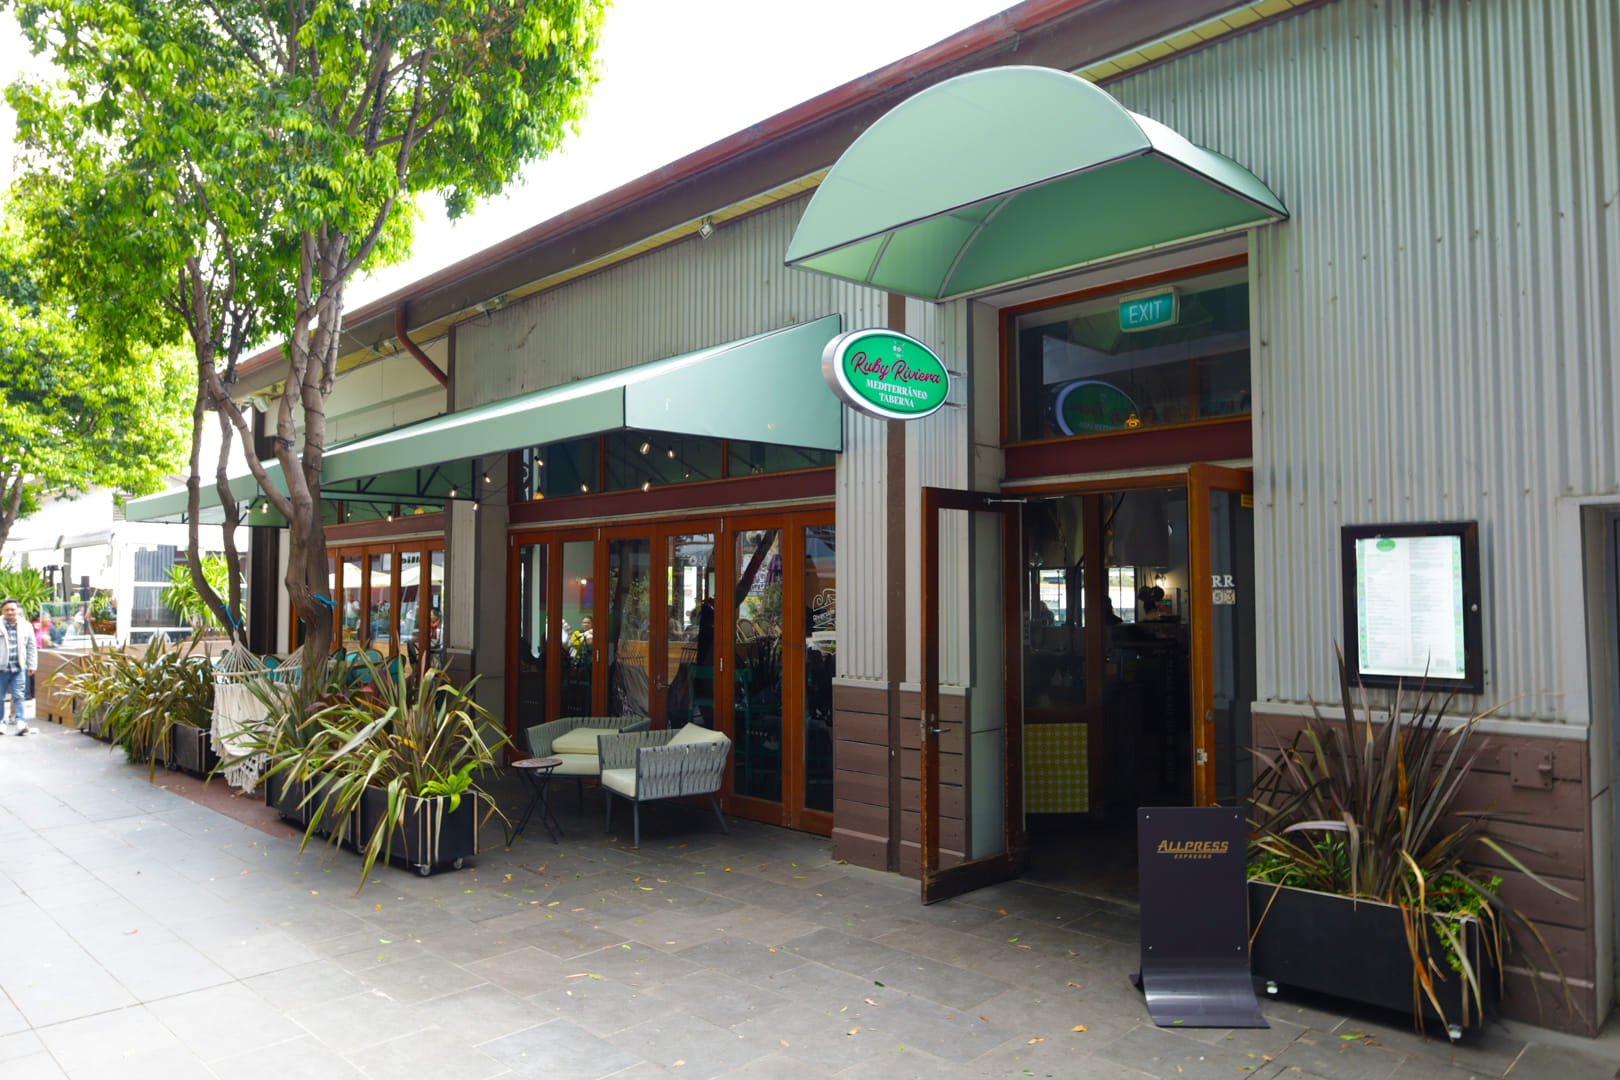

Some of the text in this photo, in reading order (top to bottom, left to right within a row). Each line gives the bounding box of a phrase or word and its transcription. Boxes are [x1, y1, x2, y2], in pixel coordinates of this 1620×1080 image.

[1129, 300, 1163, 324] EXIT
[851, 351, 942, 384] Ruby Riviera
[879, 392, 915, 408] TABERNA
[1211, 574, 1235, 588] RR
[1157, 839, 1230, 853] ALLPRESS
